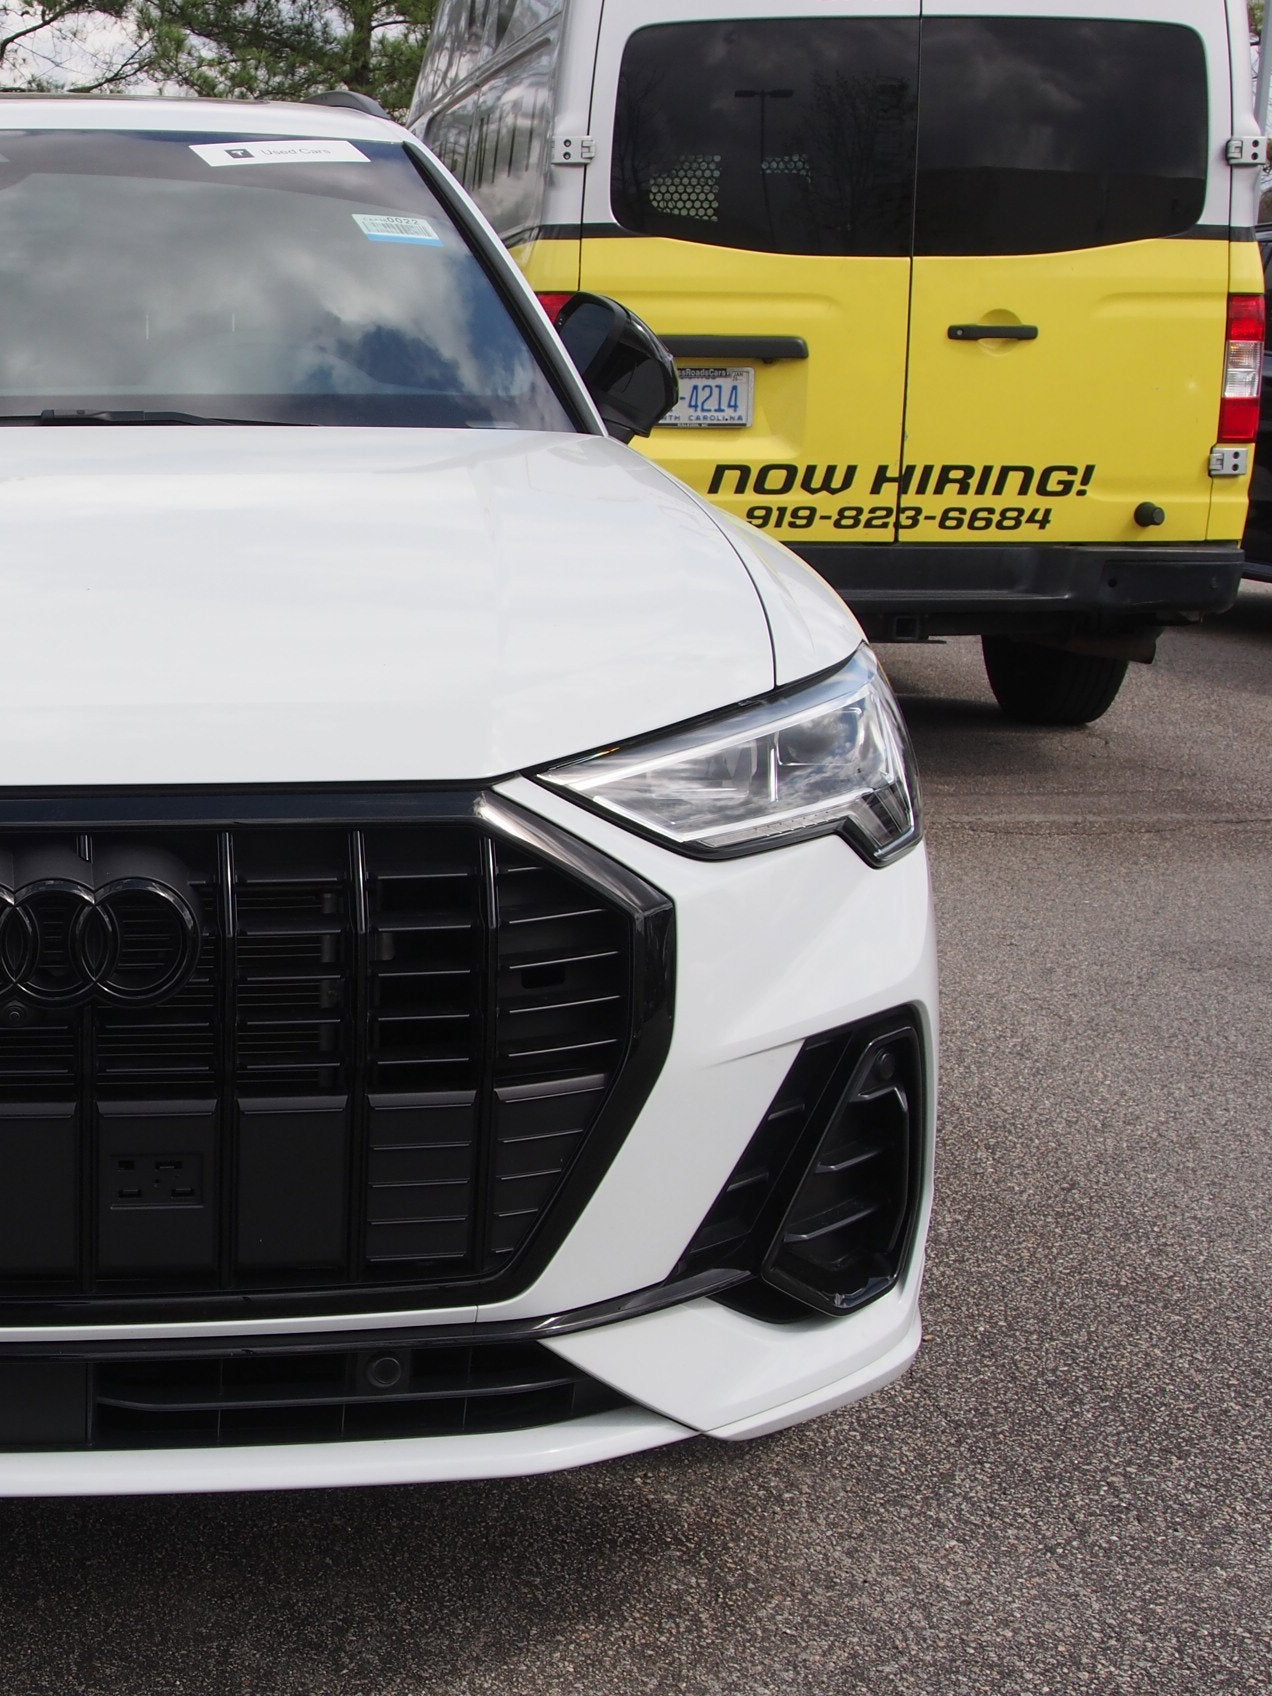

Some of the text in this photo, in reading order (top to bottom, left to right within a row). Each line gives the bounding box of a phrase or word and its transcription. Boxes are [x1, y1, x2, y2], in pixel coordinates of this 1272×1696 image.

[300, 147, 332, 155] Cars
[679, 384, 739, 413] -4214
[707, 464, 1097, 497] NOW HIRING!
[745, 505, 1053, 531] 919-823-6684
